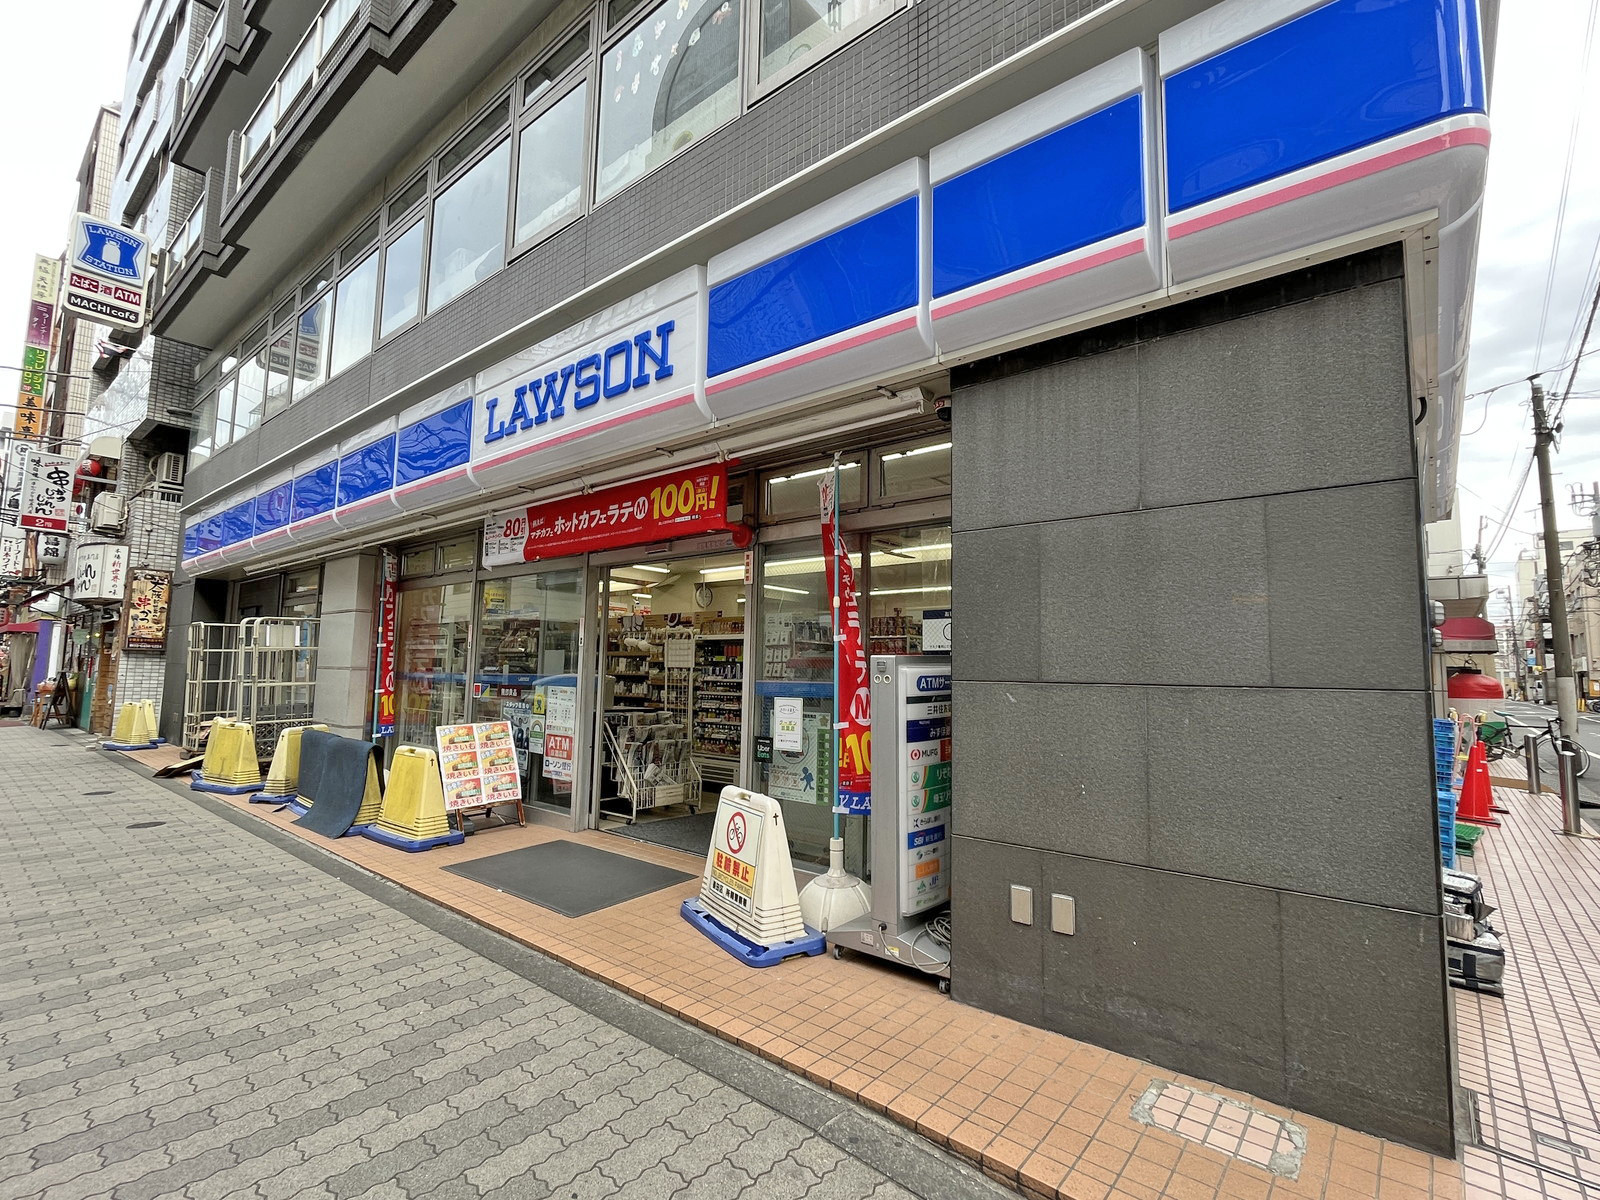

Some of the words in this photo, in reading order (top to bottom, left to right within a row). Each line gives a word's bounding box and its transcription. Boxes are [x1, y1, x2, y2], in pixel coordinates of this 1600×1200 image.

[89, 225, 138, 247] LAWSON
[85, 254, 134, 276] STATION
[72, 275, 99, 292] たばこ
[115, 288, 140, 304] ATM
[71, 296, 110, 314] MACHI
[112, 309, 137, 321] café
[485, 320, 675, 443] LAWSON
[554, 501, 634, 535] ホットカフェラテ
[530, 527, 554, 540] マチカフェ
[443, 742, 476, 753] 焼きいも
[549, 735, 570, 751] ATM
[757, 744, 770, 752] Uber
[921, 748, 939, 759] MUFG
[446, 769, 480, 780] 焼きいも
[483, 765, 515, 775] 焼きいも
[449, 797, 483, 808] 焼きいも
[487, 790, 519, 801] 焼きいも
[716, 852, 750, 883] 駐輪禁止
